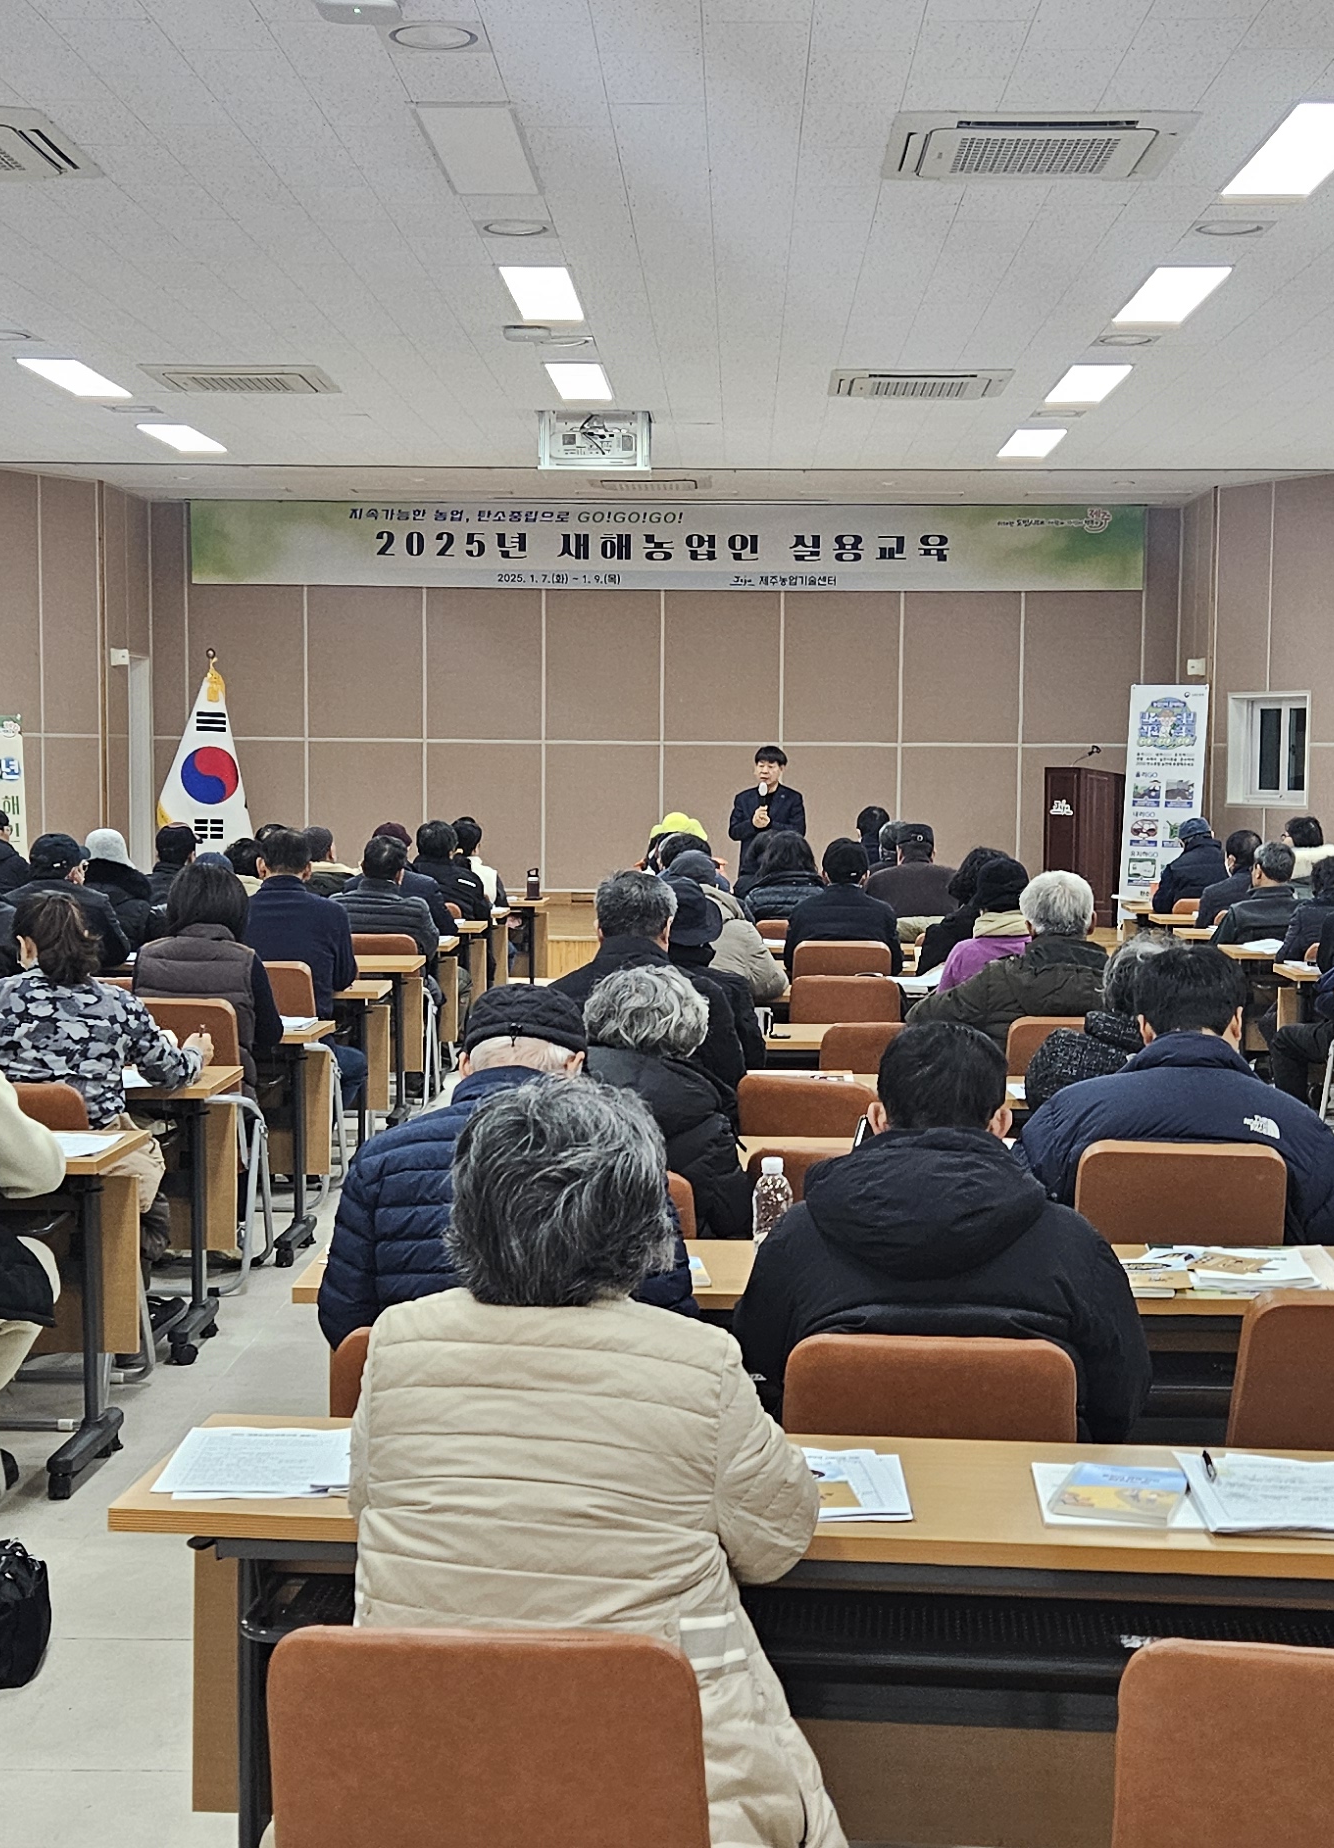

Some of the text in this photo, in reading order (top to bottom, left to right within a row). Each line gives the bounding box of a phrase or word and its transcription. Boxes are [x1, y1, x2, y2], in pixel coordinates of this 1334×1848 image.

[349, 508, 426, 521] 지속가능한
[434, 509, 470, 523] 농업,
[477, 510, 570, 523] 탄소중립으로
[375, 530, 951, 562] 2025년 새해농업인 실용교육
[497, 573, 526, 583] 2025.
[758, 575, 837, 586] 제주농업기술센터
